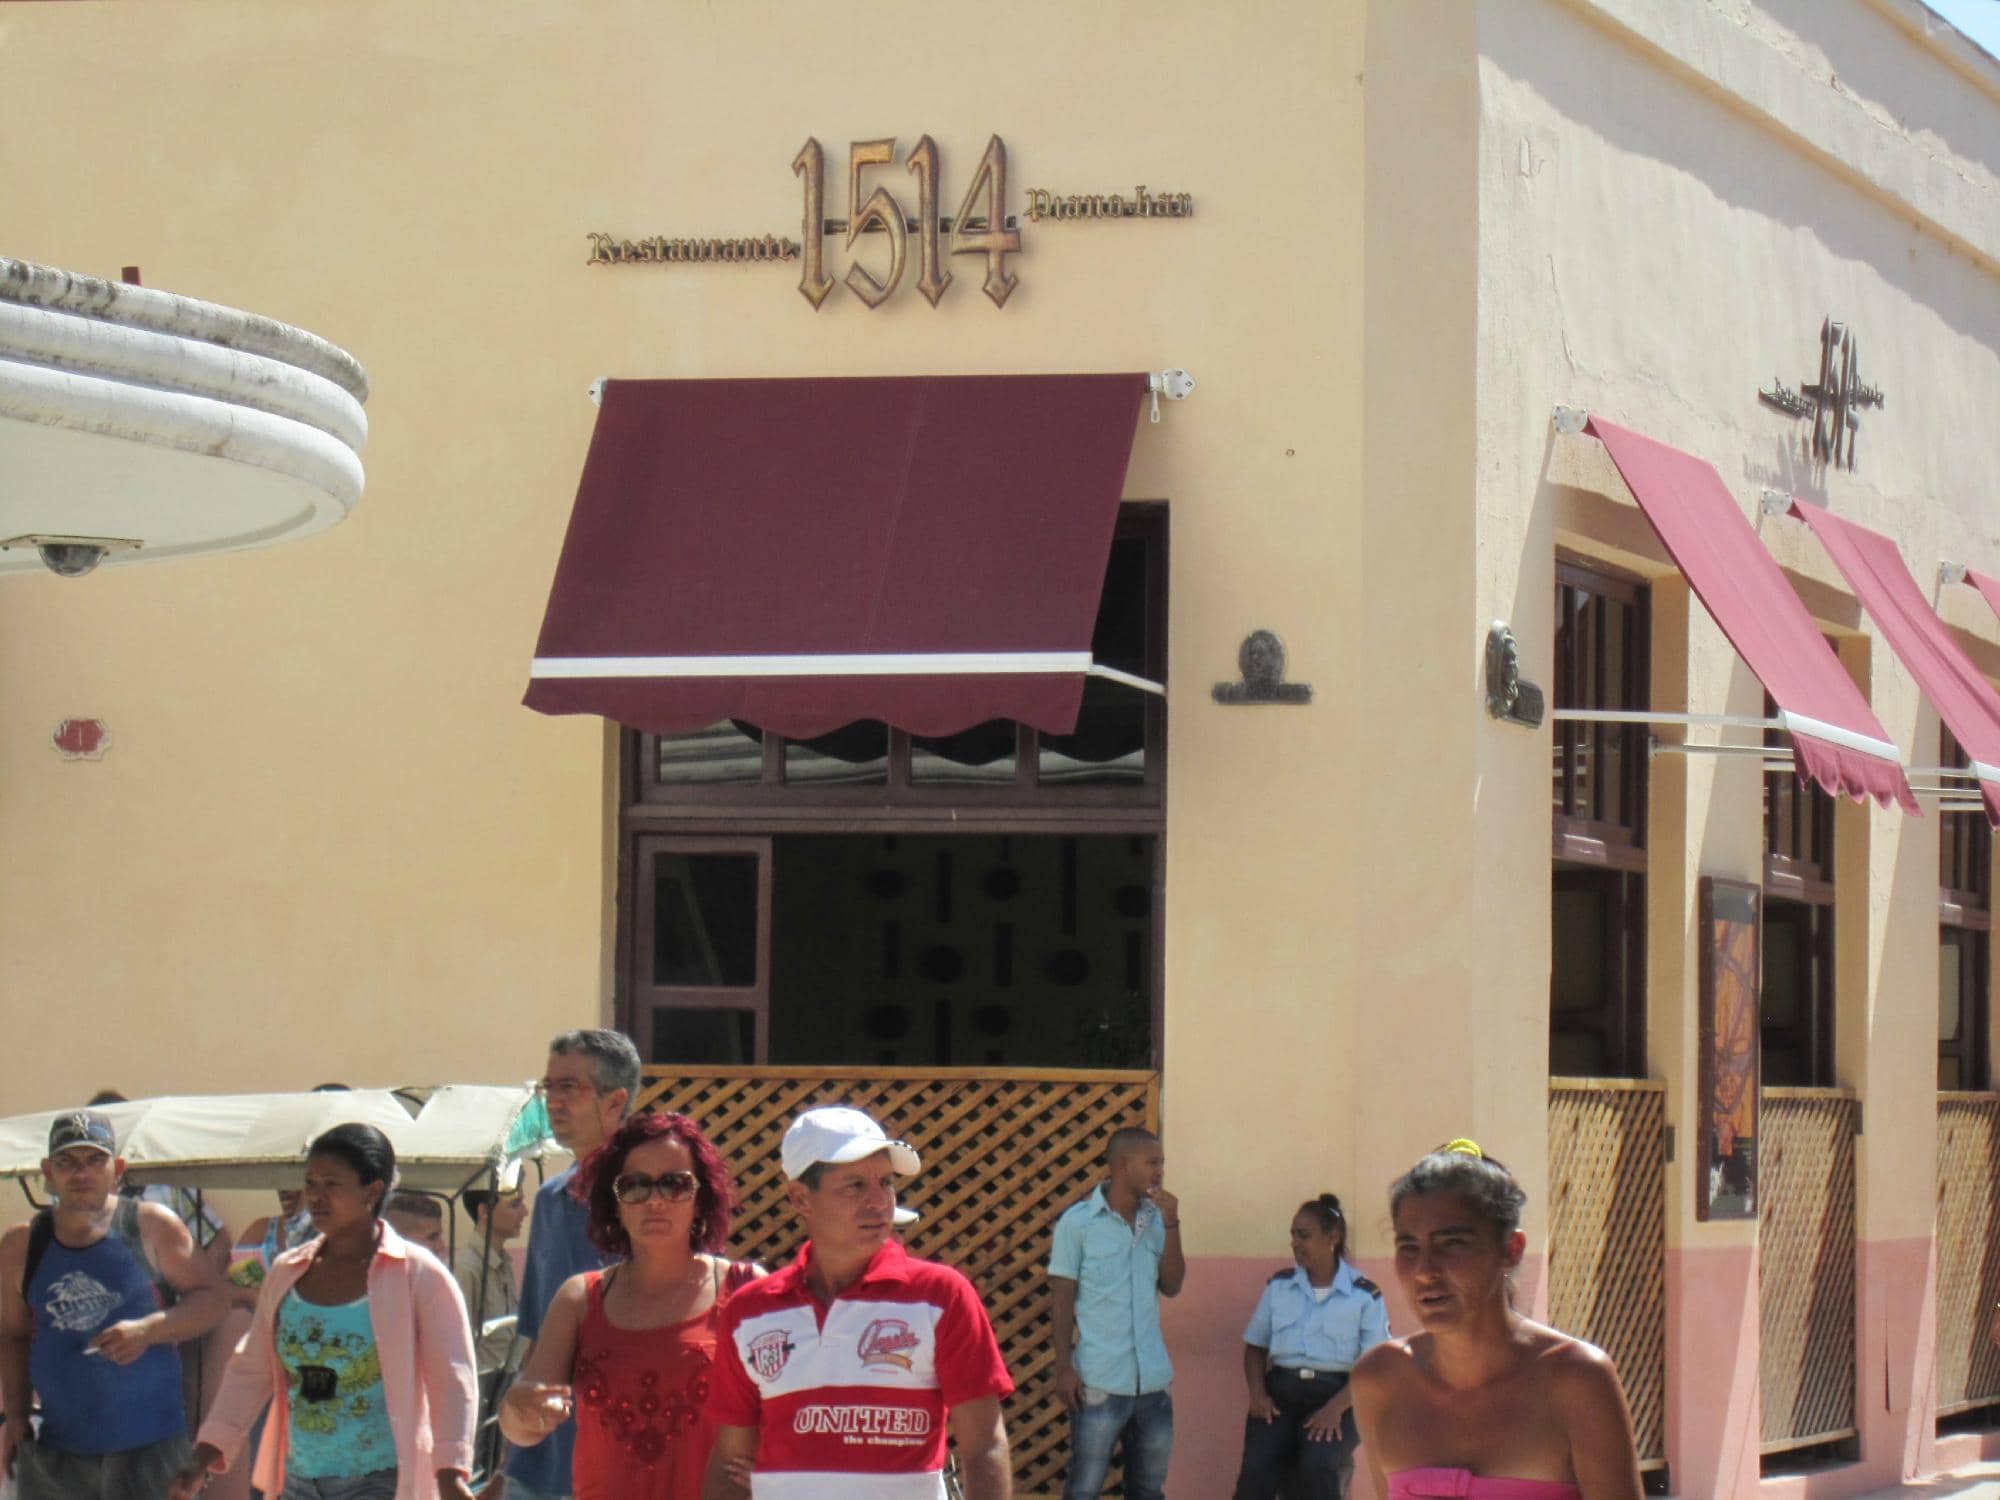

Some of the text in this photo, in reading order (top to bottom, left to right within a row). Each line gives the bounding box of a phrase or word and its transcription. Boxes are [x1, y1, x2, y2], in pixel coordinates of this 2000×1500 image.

[1024, 185, 1193, 222] Piano bar
[792, 134, 1021, 311] 1514
[586, 232, 799, 266] Restaurante
[793, 1405, 931, 1435] UNITED
[843, 1435, 865, 1445] the
